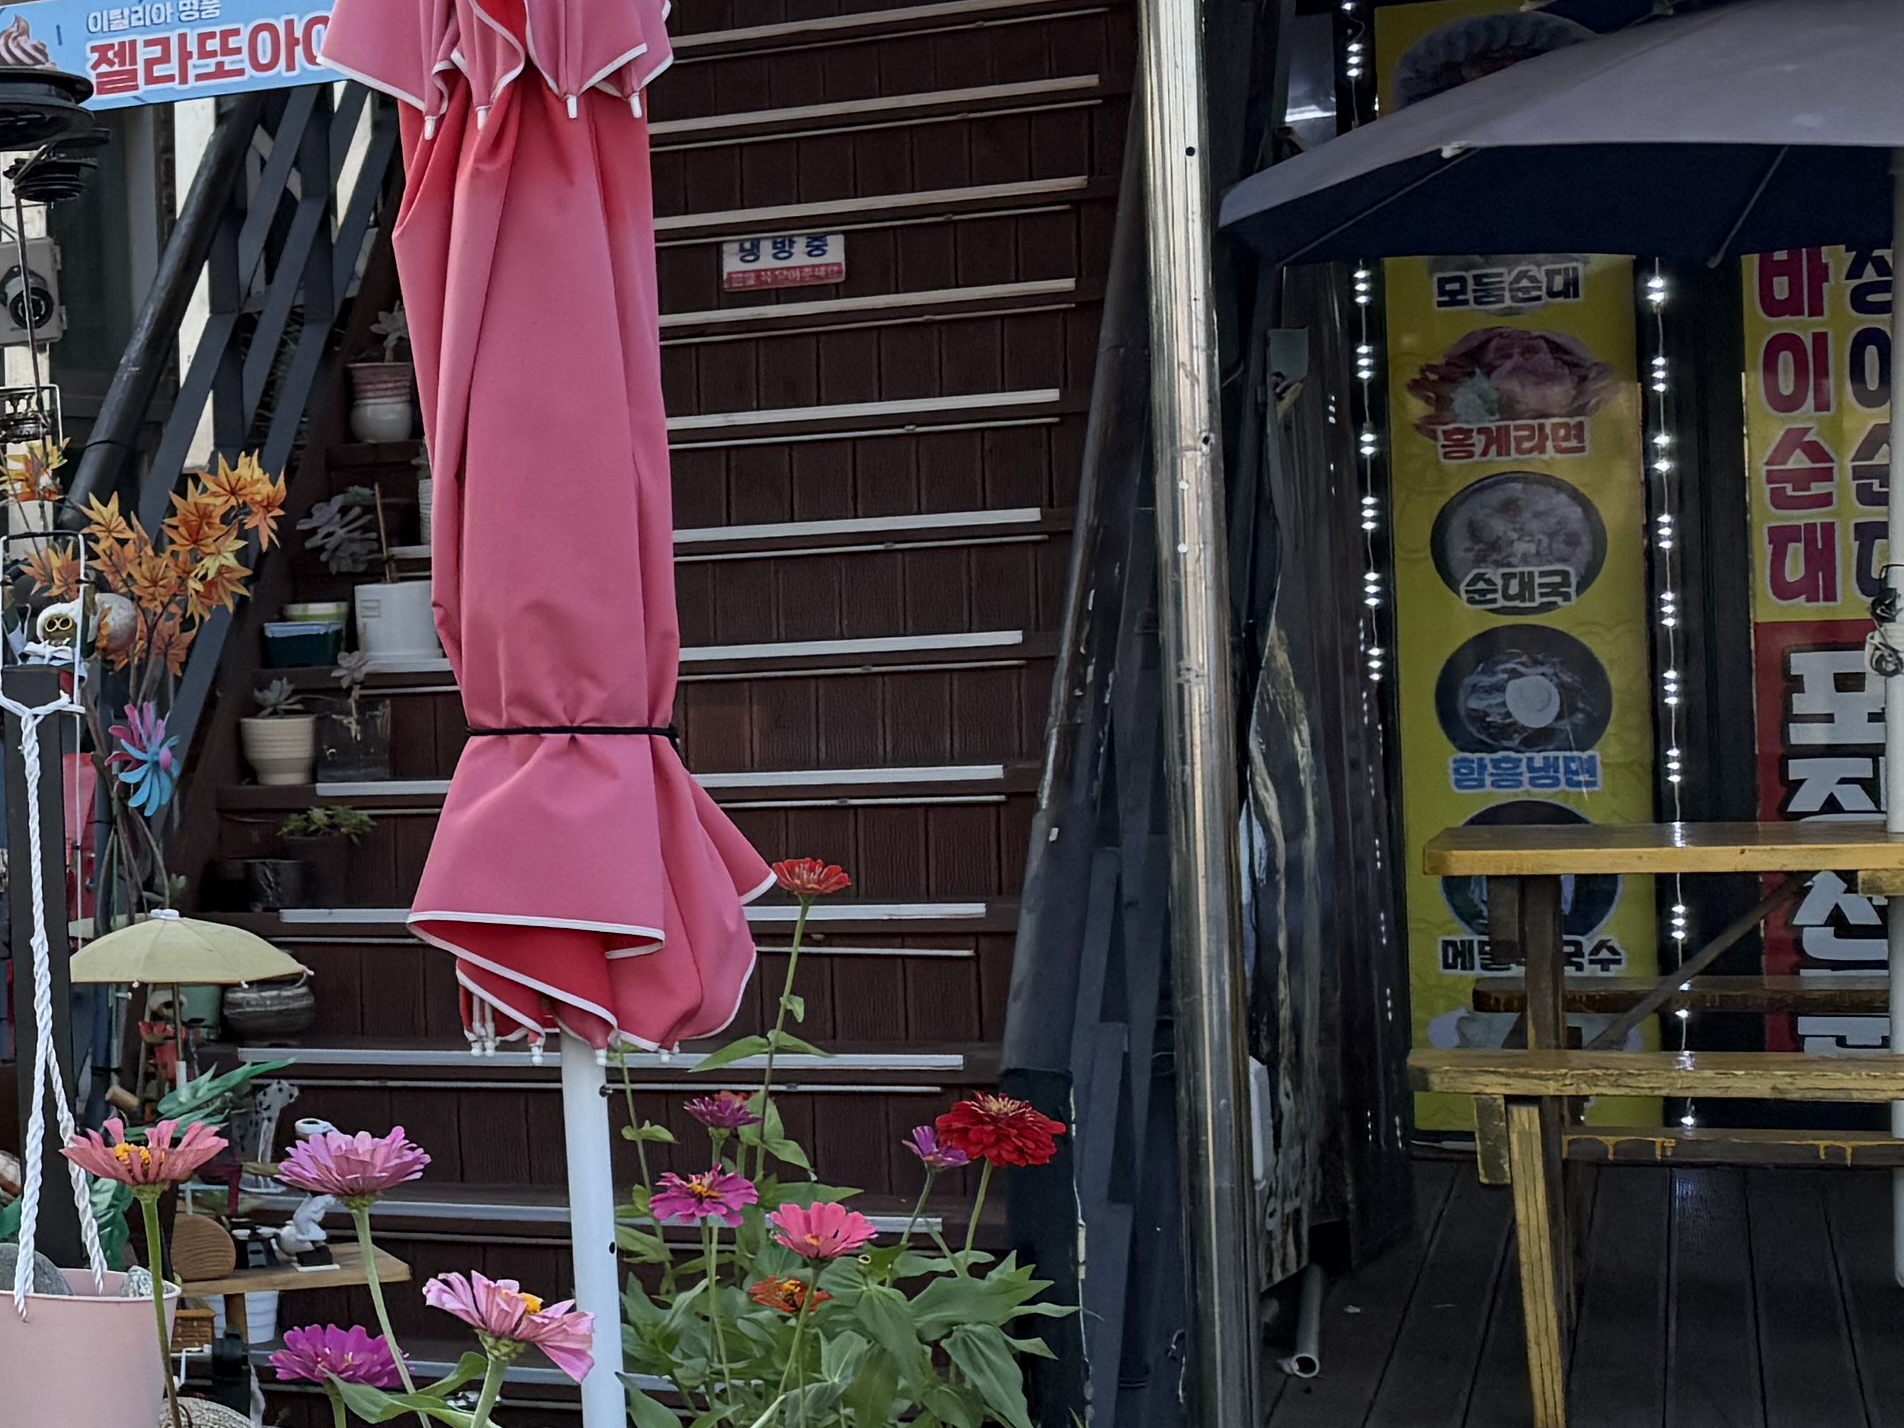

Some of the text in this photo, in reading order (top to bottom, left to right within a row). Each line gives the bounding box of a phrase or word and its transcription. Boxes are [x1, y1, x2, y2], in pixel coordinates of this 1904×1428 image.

[88, 2, 174, 33] 이탈리아
[1440, 419, 1588, 461] 홍게라면
[1464, 569, 1573, 607] 순대국
[1451, 752, 1600, 791] 함흥냉면
